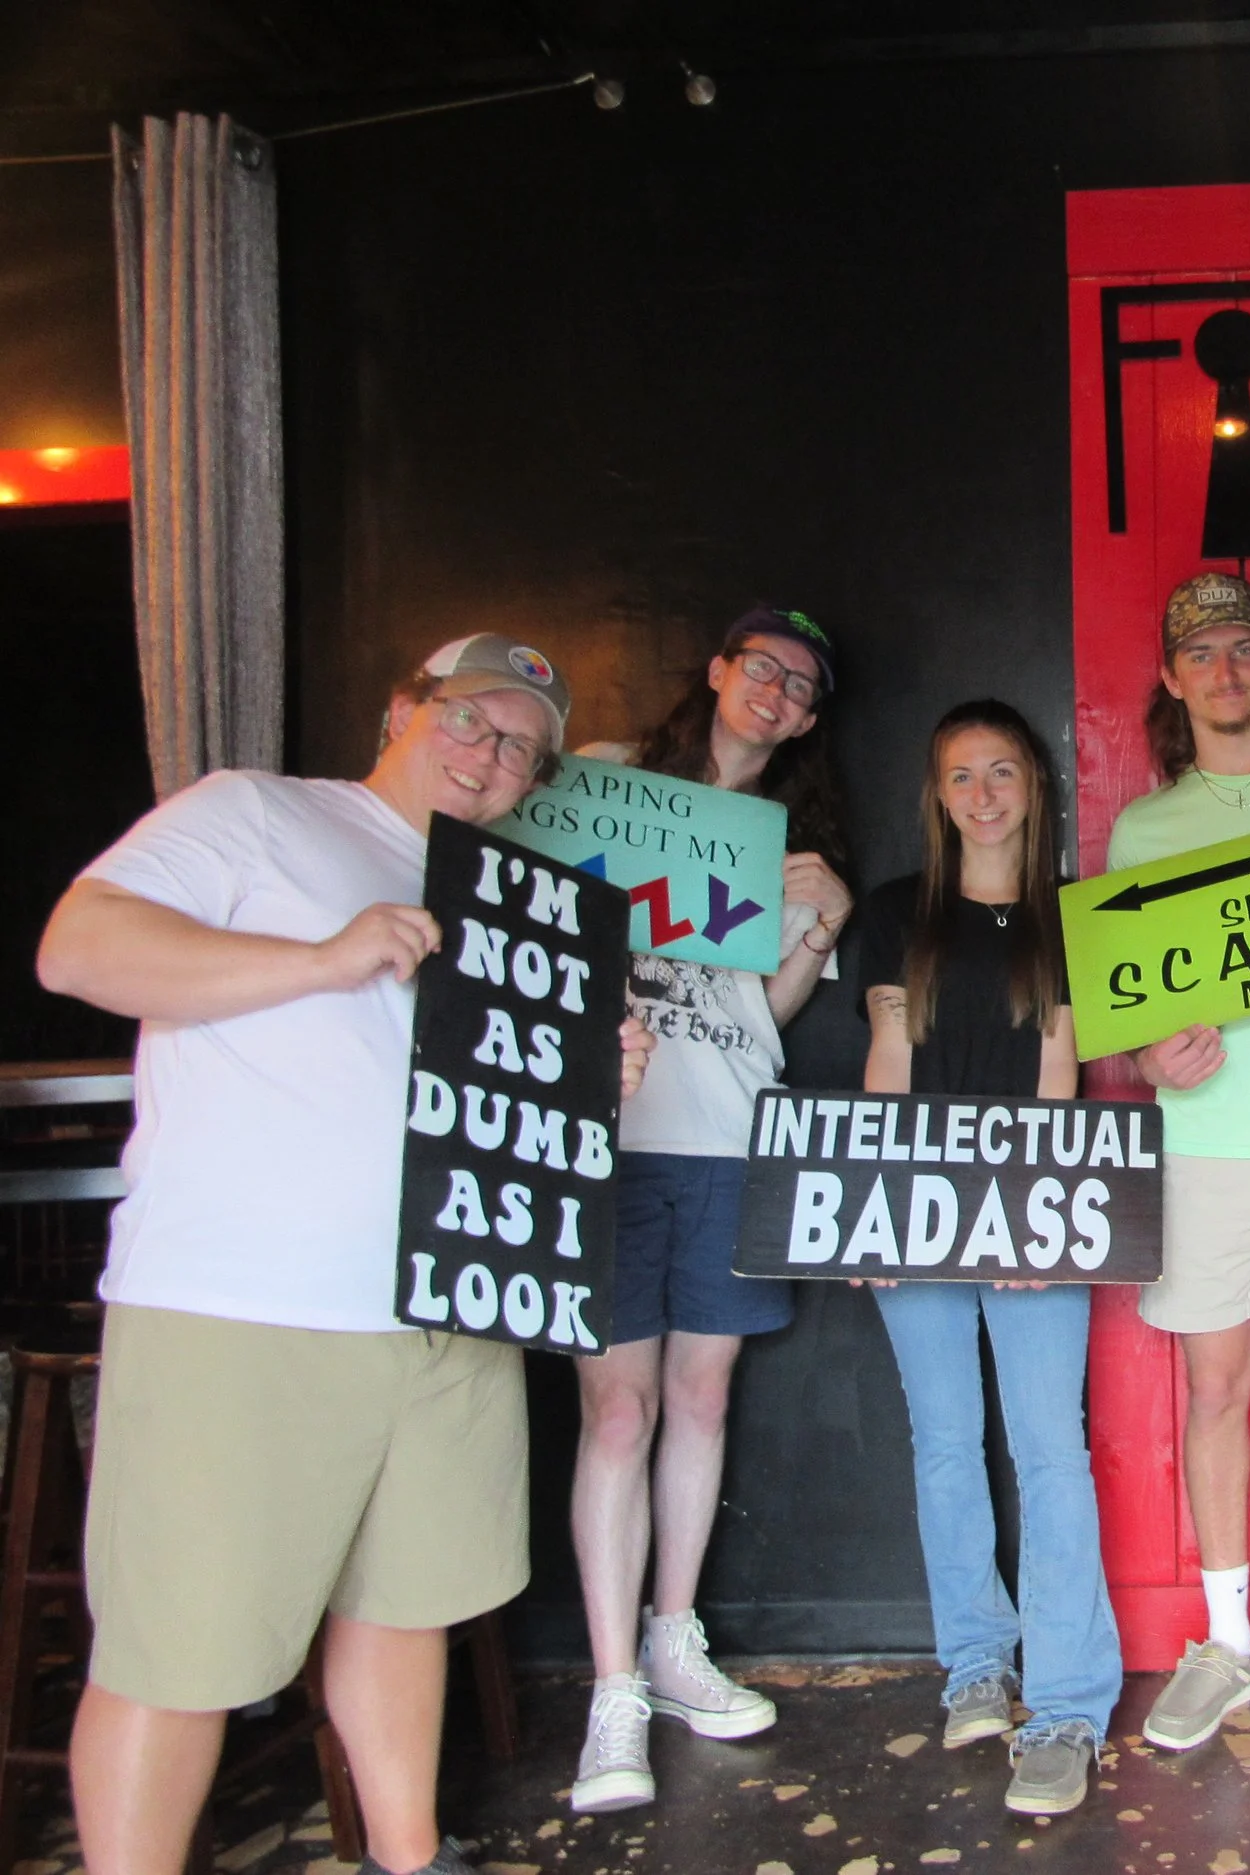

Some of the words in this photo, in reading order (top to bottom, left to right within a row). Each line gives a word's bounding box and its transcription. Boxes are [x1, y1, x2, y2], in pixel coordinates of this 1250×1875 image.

[1199, 589, 1234, 601] DUX
[592, 814, 675, 853] OUT
[688, 834, 746, 868] MY
[476, 846, 581, 937] I'M
[457, 918, 591, 1014] NOT
[473, 1008, 564, 1083] AS
[408, 1070, 613, 1180] DUMB
[757, 1097, 1157, 1169] INTELLECTUAL
[435, 1169, 534, 1246] AS
[555, 1197, 583, 1258] I
[787, 1171, 1112, 1270] BADASS
[408, 1253, 600, 1350] LOOK
